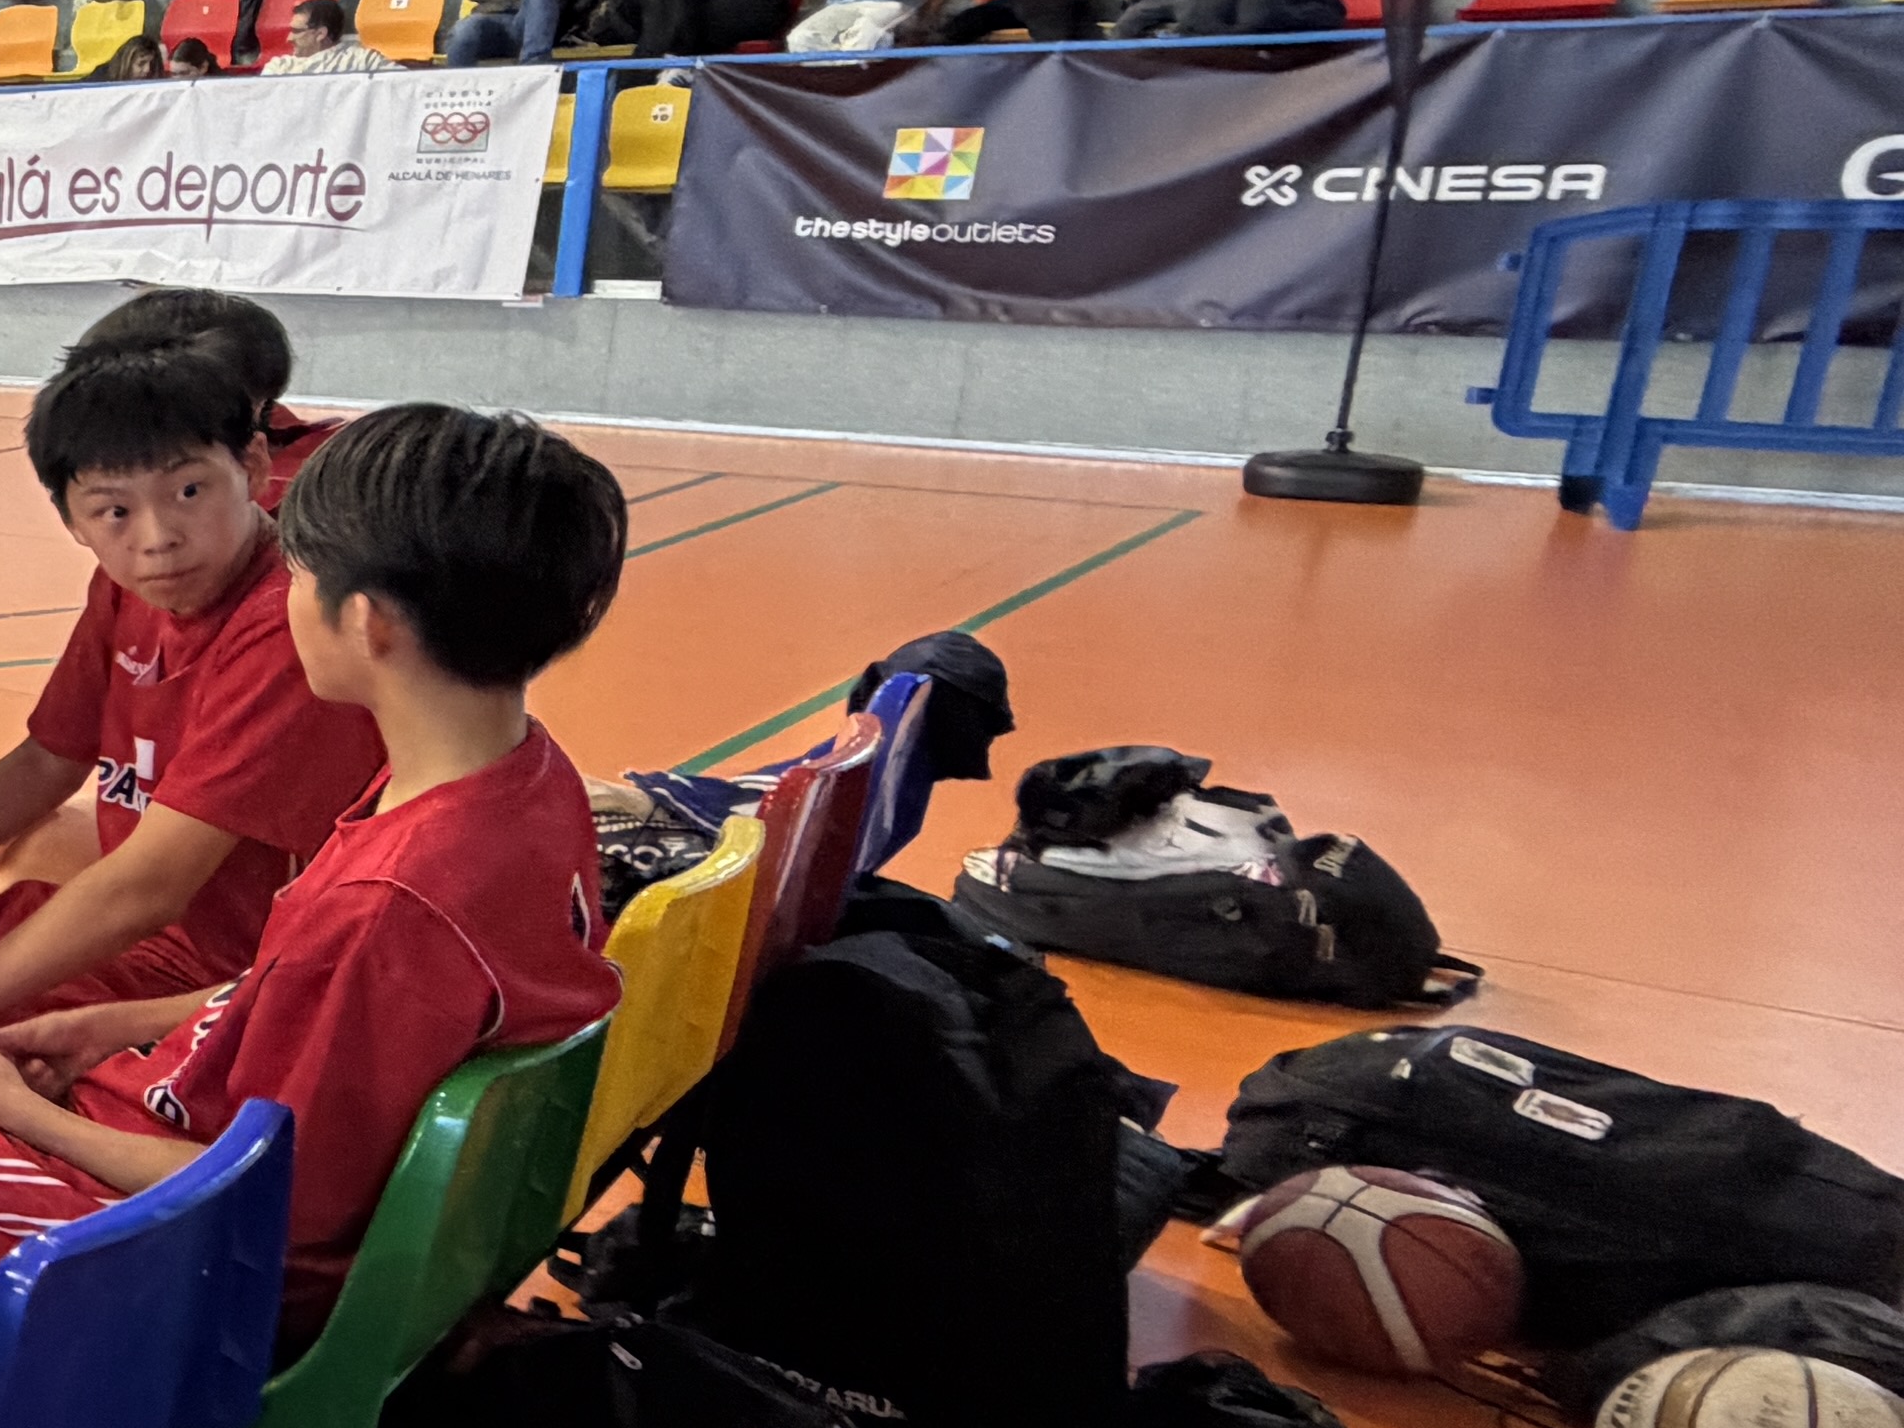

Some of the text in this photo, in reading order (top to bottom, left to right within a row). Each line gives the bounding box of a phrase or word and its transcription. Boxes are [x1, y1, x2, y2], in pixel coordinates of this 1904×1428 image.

[68, 167, 123, 214] es
[137, 147, 366, 243] deporte
[1312, 164, 1607, 202] CINESA
[794, 215, 1057, 247] thestyleoutlets
